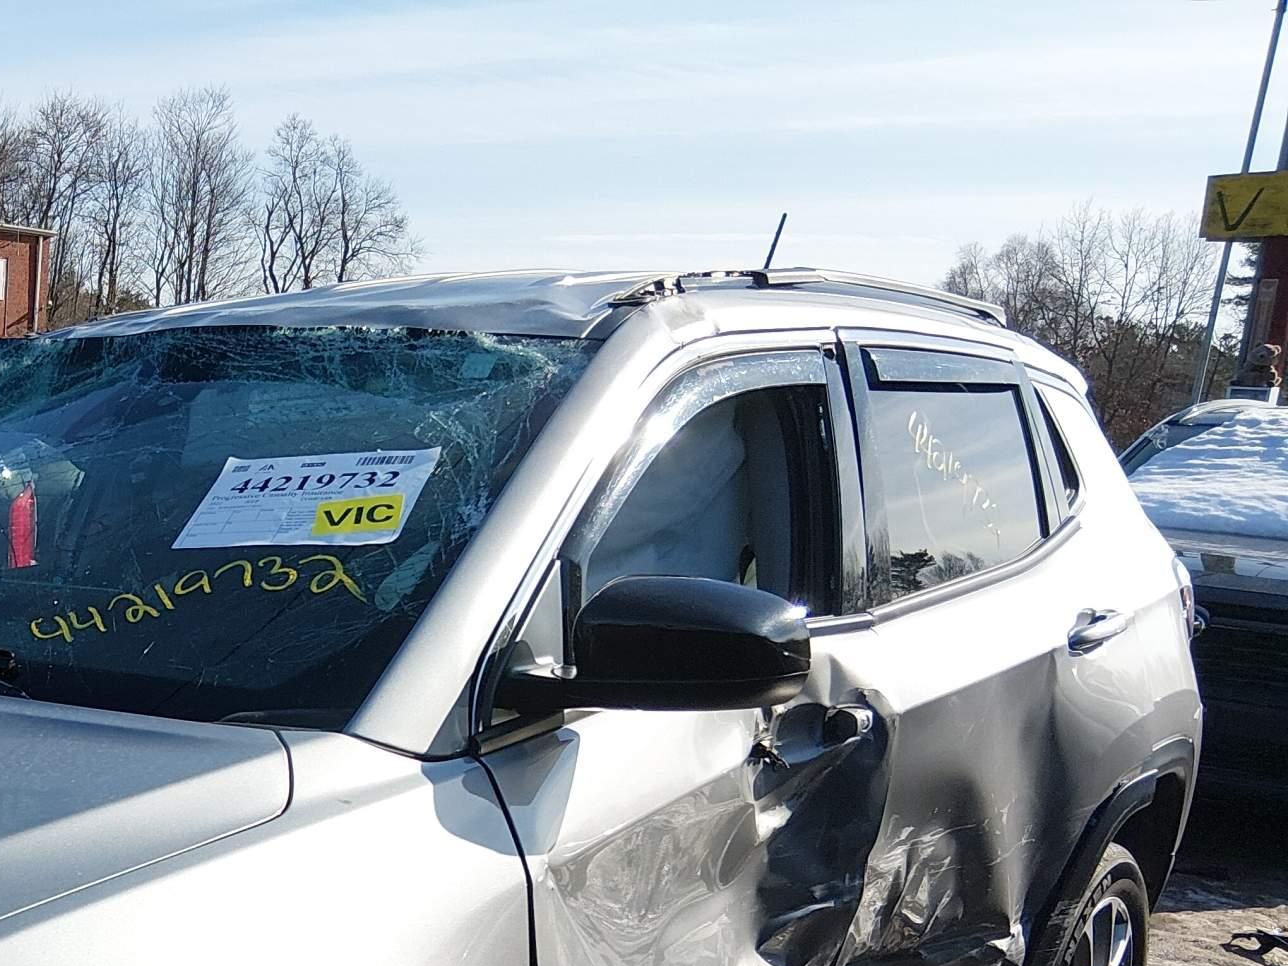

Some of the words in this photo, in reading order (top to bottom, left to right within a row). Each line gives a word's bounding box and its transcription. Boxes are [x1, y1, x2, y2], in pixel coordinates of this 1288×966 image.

[230, 471, 401, 494] 44219732
[323, 503, 395, 527] VIC
[30, 555, 369, 643] 44219732
